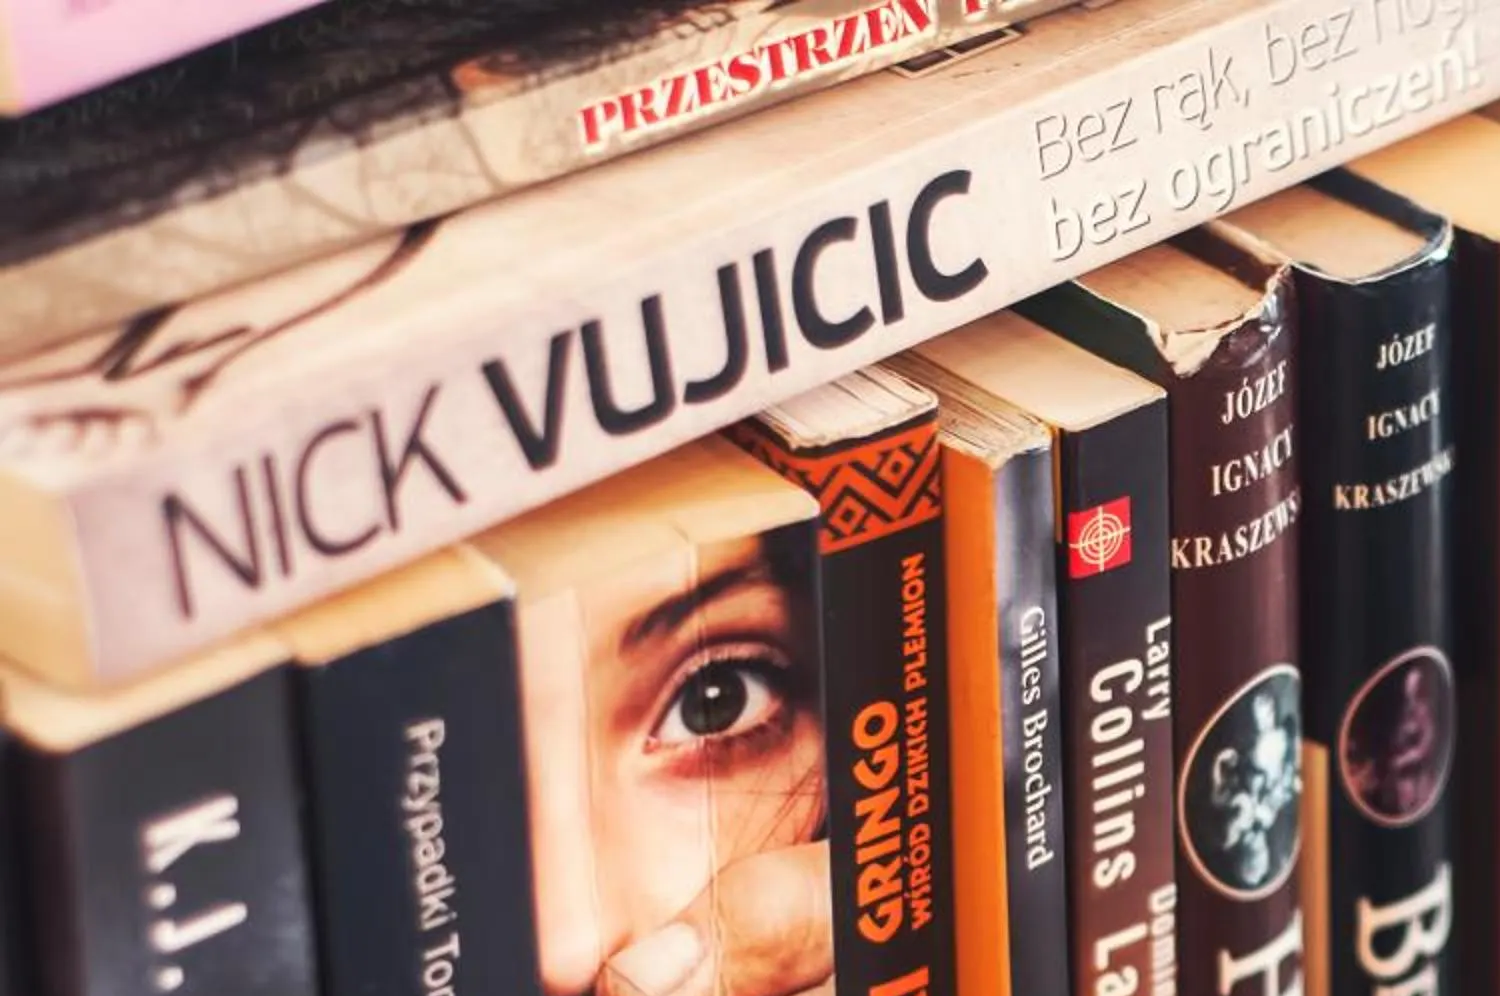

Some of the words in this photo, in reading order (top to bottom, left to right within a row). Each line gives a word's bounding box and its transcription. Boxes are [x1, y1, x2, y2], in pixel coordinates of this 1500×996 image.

[1034, 97, 1138, 181] Bez
[1152, 47, 1250, 132] rąk,
[1265, 4, 1359, 85] bez
[1050, 180, 1152, 263] bez
[1171, 28, 1486, 221] ograniczeń!
[161, 385, 468, 620] NICK
[482, 169, 988, 473] VUJICIC
[1221, 360, 1288, 425] JÓZEF
[1377, 323, 1436, 370] JÓZEF
[1211, 424, 1294, 496] IGNACY
[1367, 388, 1440, 440] IGNACY
[902, 552, 927, 692] PLEMION
[1019, 605, 1046, 705] Gilles
[1141, 616, 1171, 722] Larry
[400, 715, 460, 933] Przypadki
[852, 700, 903, 944] GRINGO
[901, 697, 932, 822] DZIKICH
[1021, 708, 1056, 871] Brochard
[1090, 657, 1144, 889] Collins
[902, 826, 933, 931] WŚRÓD
